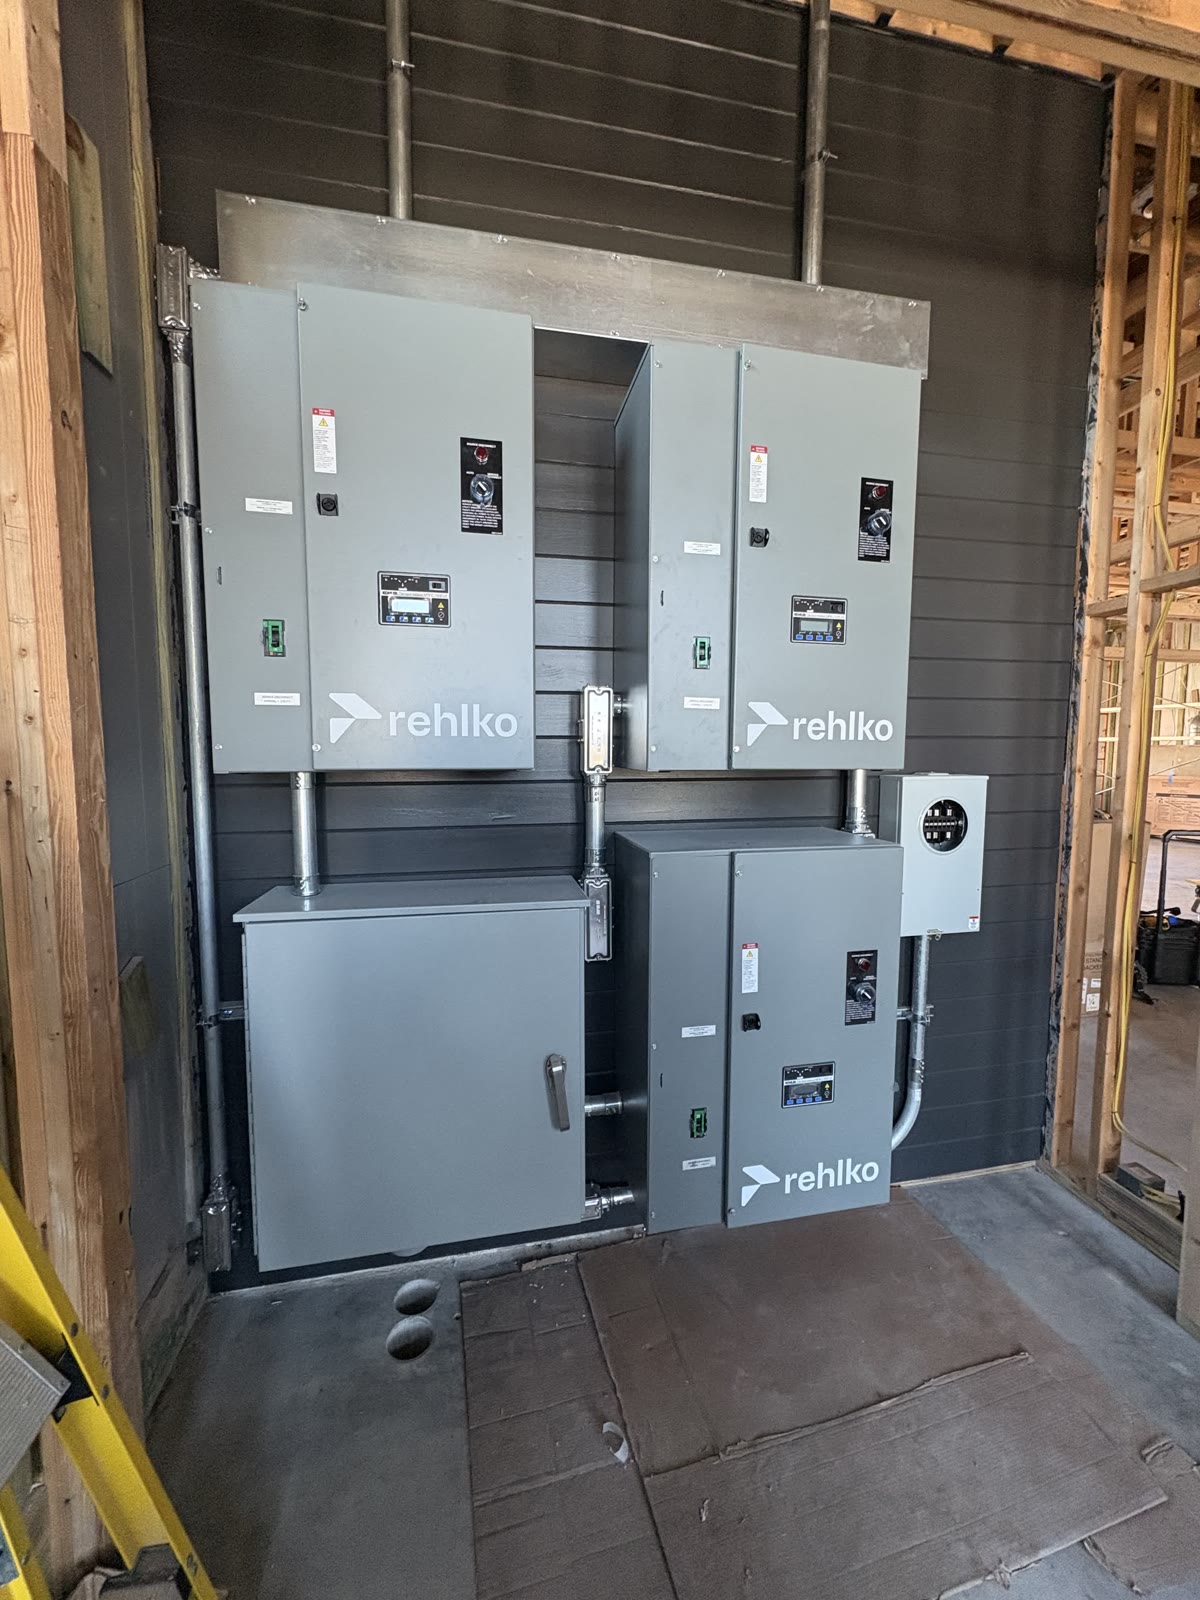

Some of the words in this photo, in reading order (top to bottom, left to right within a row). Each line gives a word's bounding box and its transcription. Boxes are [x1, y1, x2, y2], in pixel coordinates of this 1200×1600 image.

[389, 703, 518, 737] rehlko
[793, 711, 894, 741] rehlko
[784, 1158, 880, 1194] rehlko
